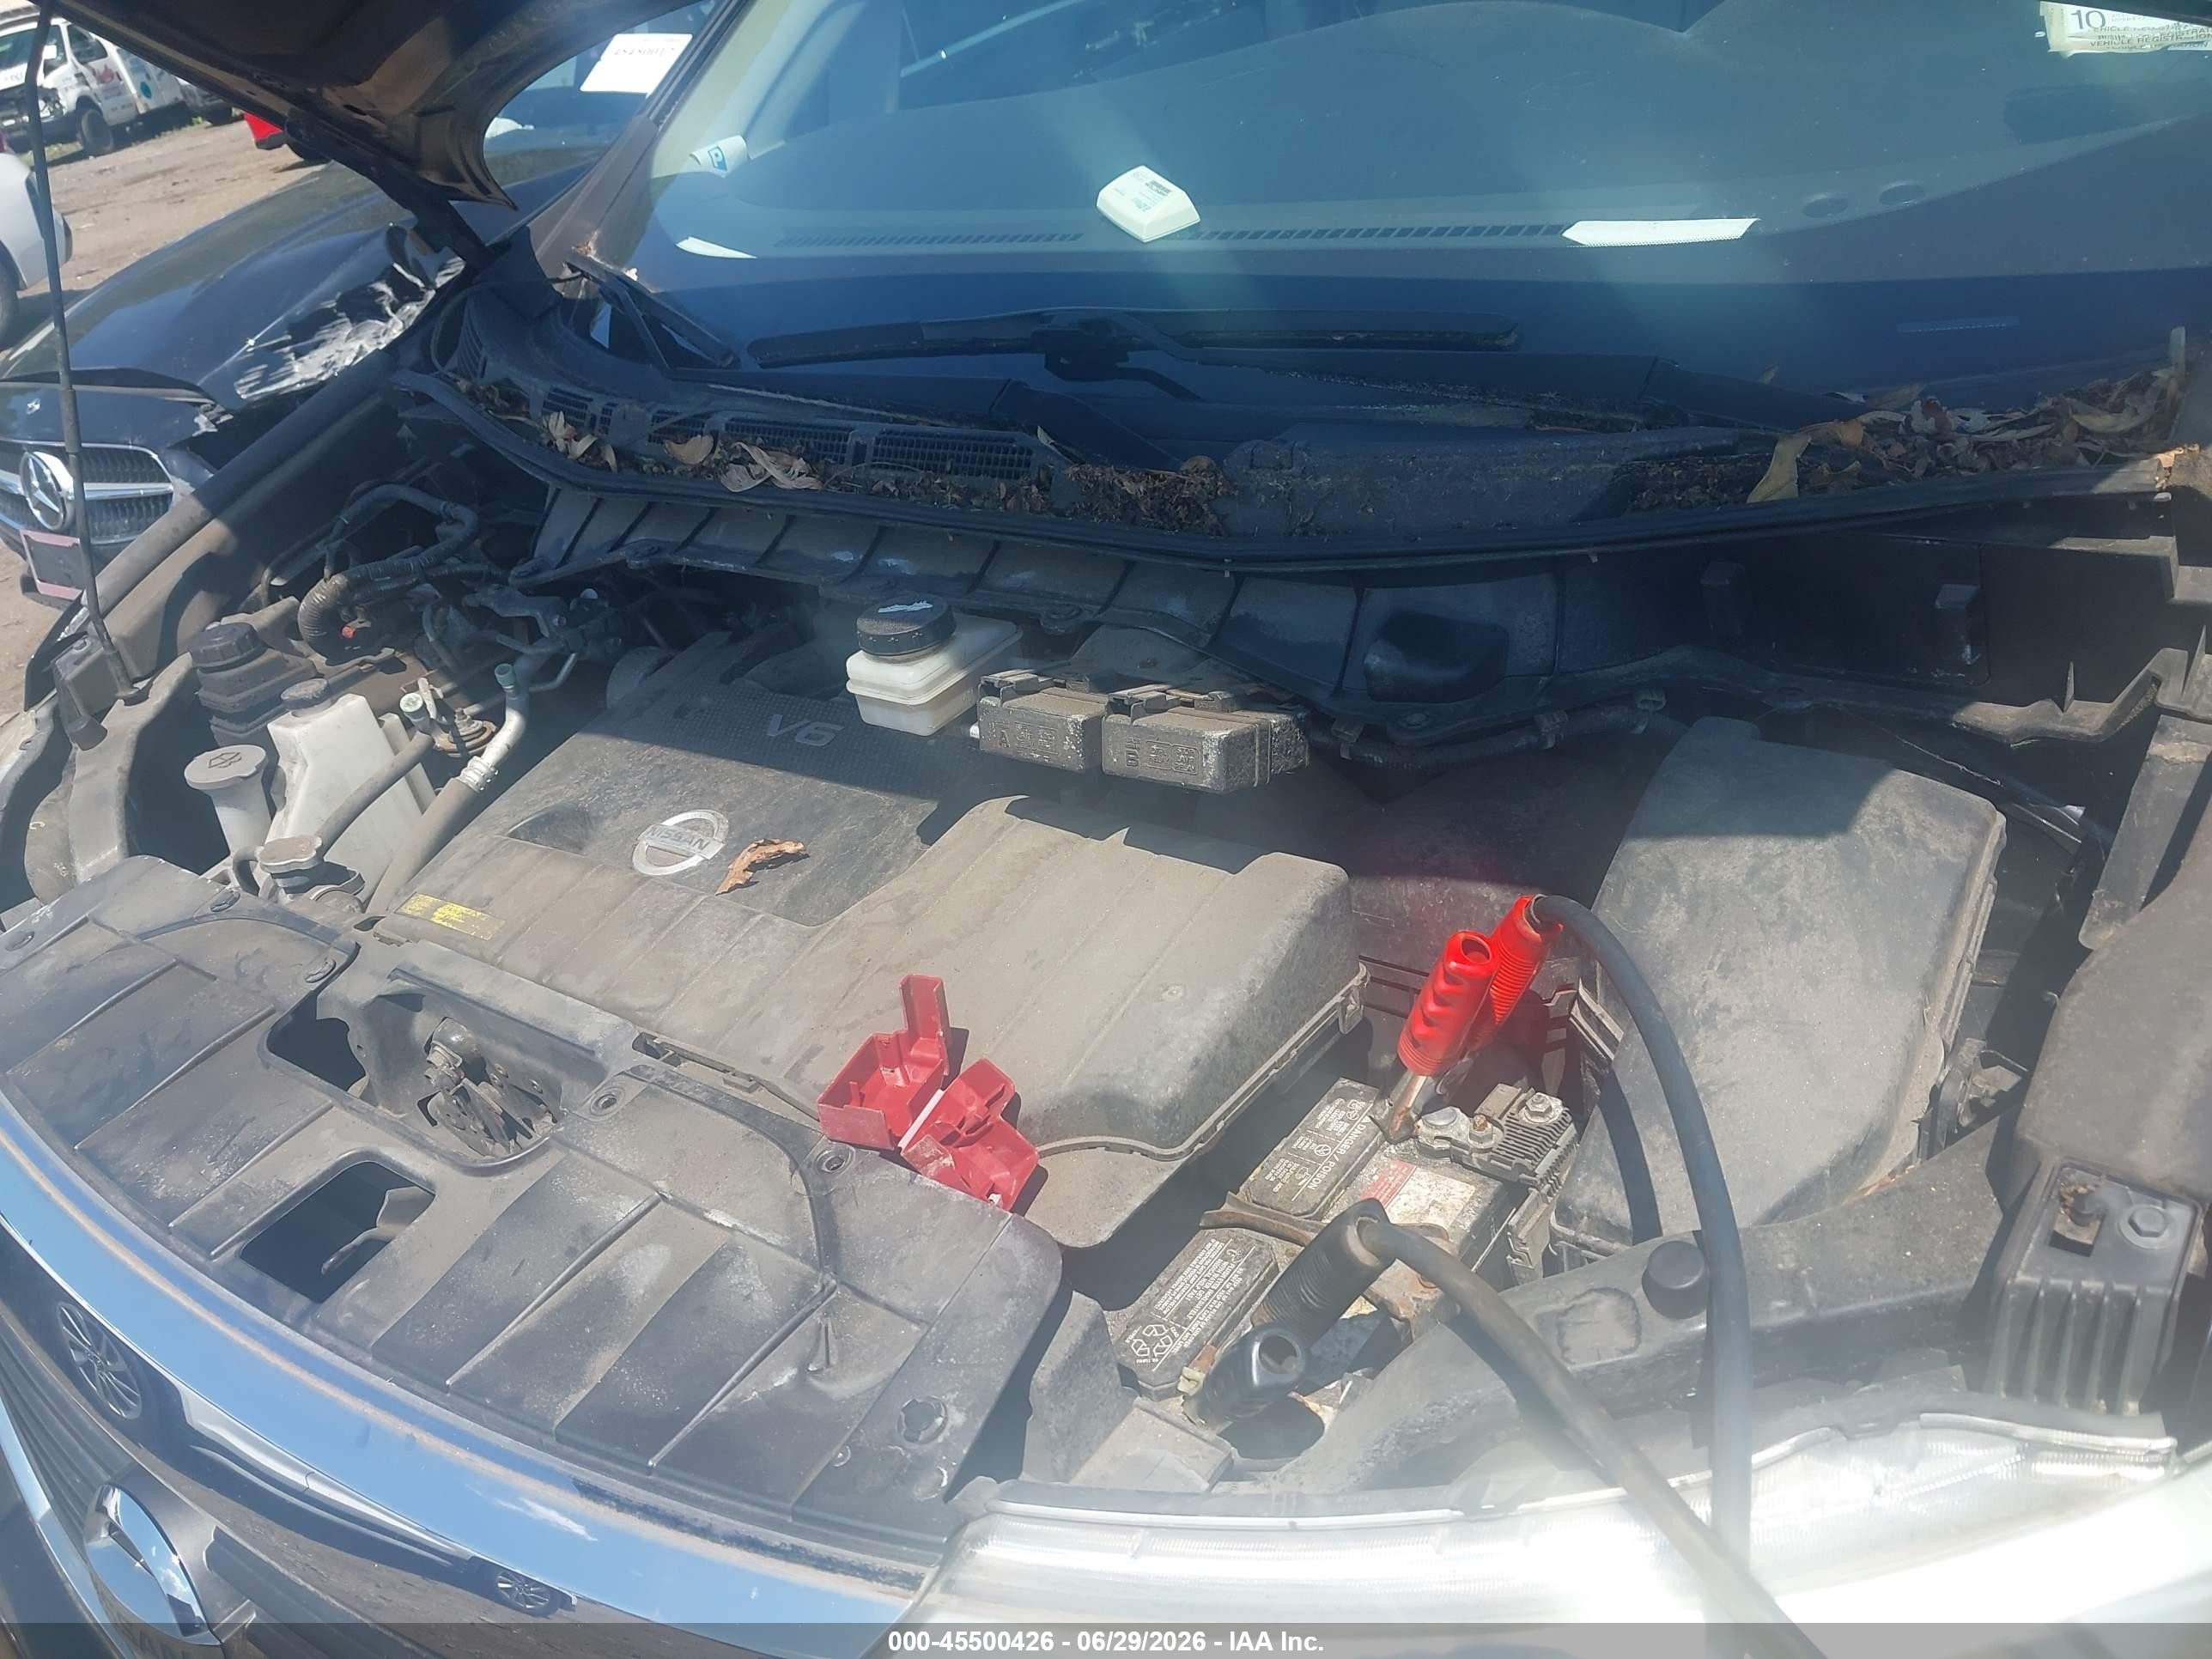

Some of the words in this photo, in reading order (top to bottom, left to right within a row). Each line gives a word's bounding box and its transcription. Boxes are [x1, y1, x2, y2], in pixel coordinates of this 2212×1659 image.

[2070, 9, 2106, 30] 10
[767, 714, 844, 747] V6
[646, 825, 711, 850] NISSAN
[1334, 1123, 1367, 1155] DANGER
[1306, 1160, 1336, 1189] POISON
